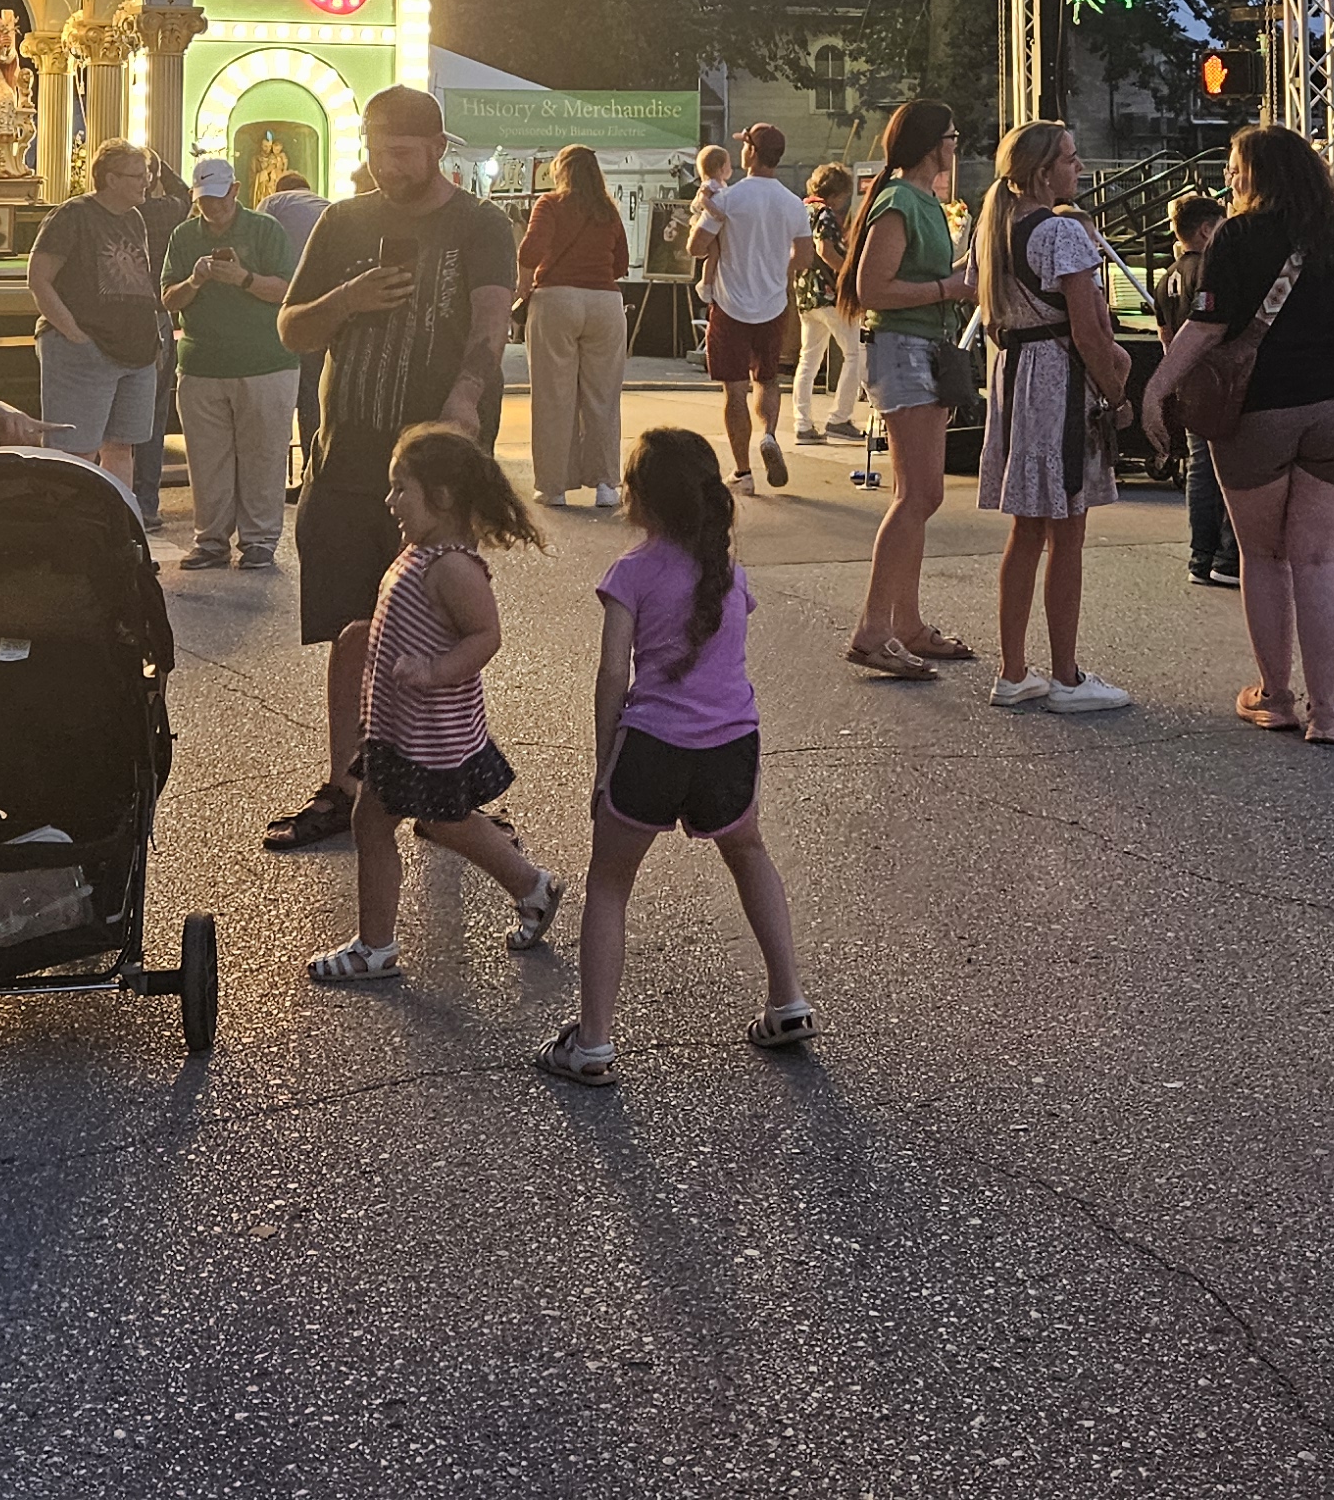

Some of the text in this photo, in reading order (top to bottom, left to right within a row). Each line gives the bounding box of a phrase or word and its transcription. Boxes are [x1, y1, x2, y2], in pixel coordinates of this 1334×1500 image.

[462, 97, 682, 123] History & Merchandise
[499, 124, 553, 138] Sponsored
[555, 124, 568, 139] by
[570, 124, 605, 137] Bianco
